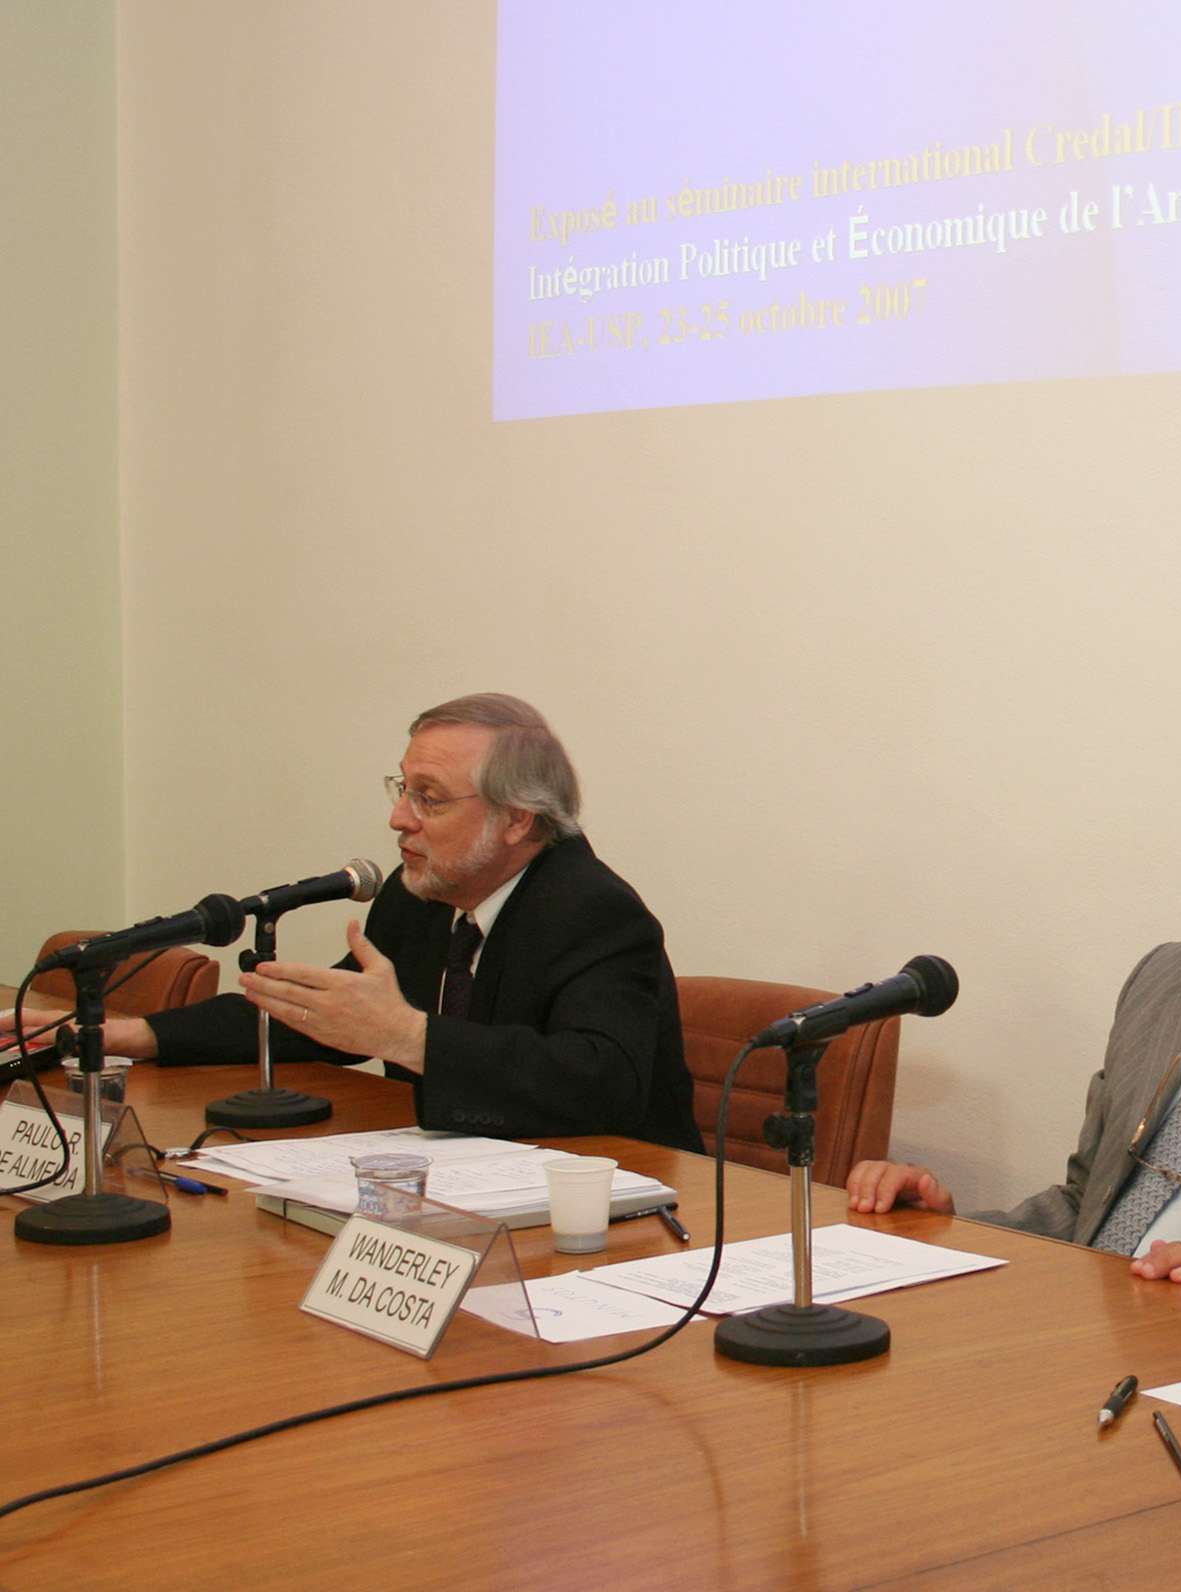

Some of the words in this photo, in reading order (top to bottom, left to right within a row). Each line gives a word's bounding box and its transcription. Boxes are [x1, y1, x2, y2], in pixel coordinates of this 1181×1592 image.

[529, 189, 618, 247] Exposé
[626, 196, 659, 226] au
[666, 168, 804, 220] séminaire
[812, 128, 1014, 199] international
[527, 256, 672, 303] Intégration
[679, 236, 804, 282] Politique
[811, 228, 838, 265] et
[849, 204, 1050, 255] Économique
[1059, 190, 1100, 234] de
[528, 310, 651, 359] IEA-USP,
[658, 300, 733, 345] 23-25
[738, 291, 847, 335] octobre
[856, 278, 928, 325] 2007
[325, 1269, 350, 1298] M.
[347, 1276, 377, 1309] DA
[375, 1286, 436, 1330] COSTA
[348, 1232, 460, 1289] WANDERLEY
